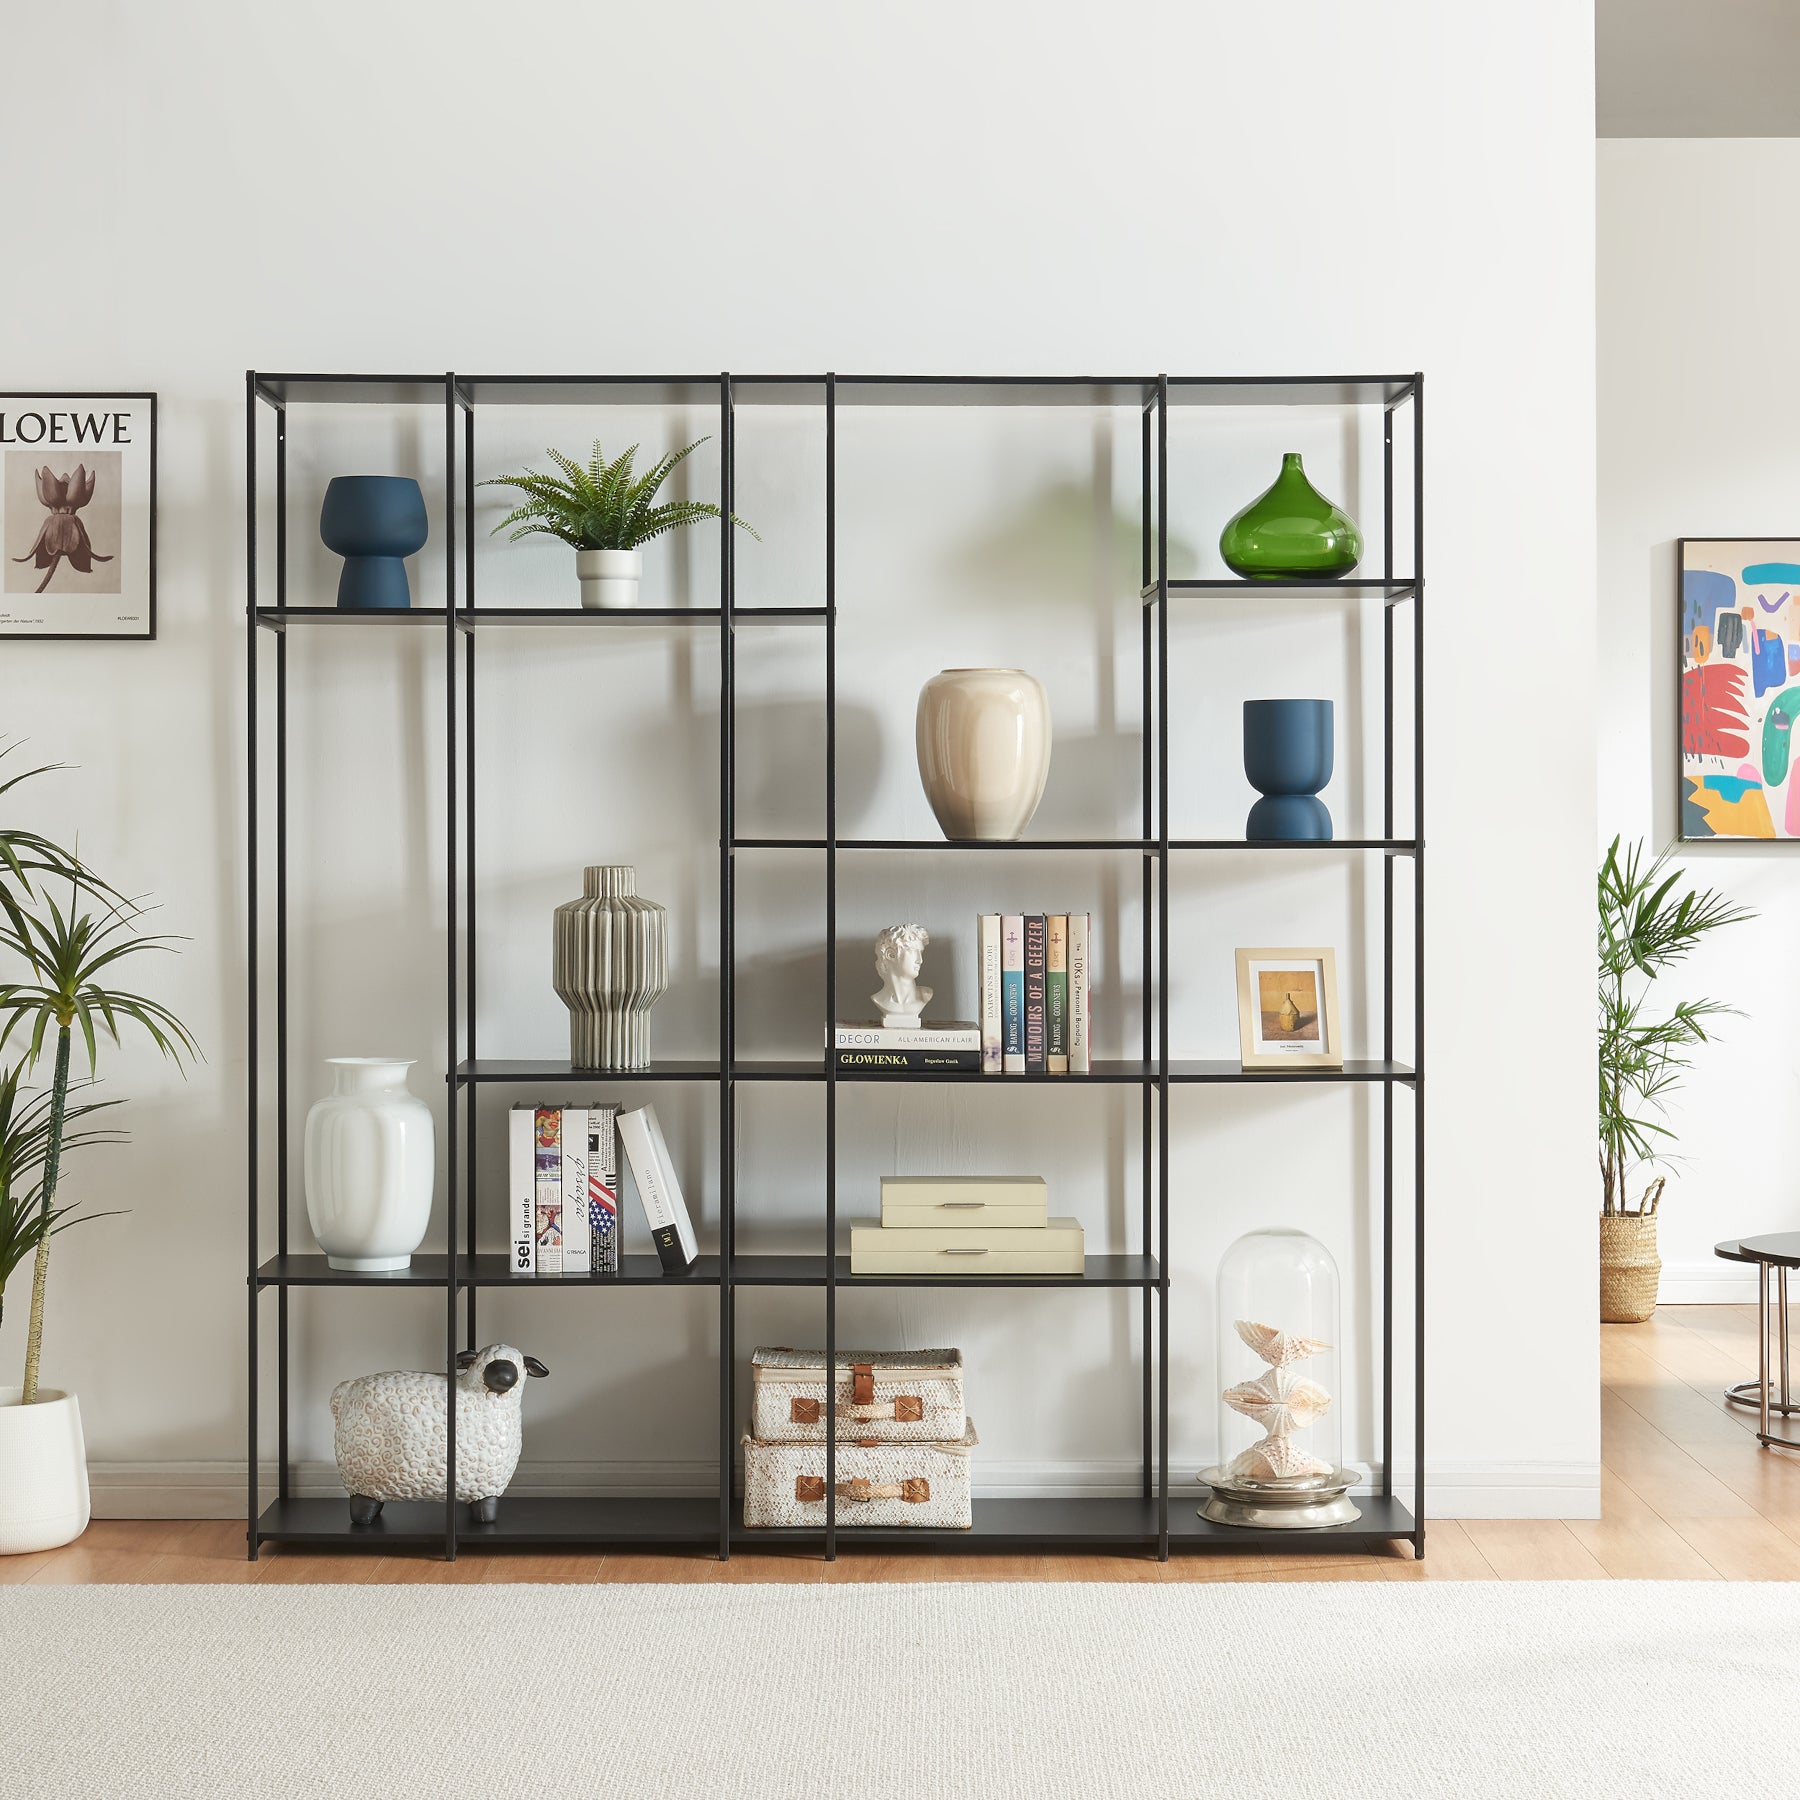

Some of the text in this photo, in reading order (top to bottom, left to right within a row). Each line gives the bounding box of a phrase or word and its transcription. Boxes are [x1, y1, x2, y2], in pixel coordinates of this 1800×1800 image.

[0, 412, 132, 443] LOEWE
[1028, 922, 1042, 966] GEEZER
[1074, 957, 1083, 979] 10Ks
[1028, 984, 1042, 1000] OF
[839, 1034, 880, 1044] DECOR
[1028, 1005, 1042, 1062] MEMOIRS
[840, 1054, 908, 1065] GŁOWIENKA
[514, 1240, 530, 1268] sei
